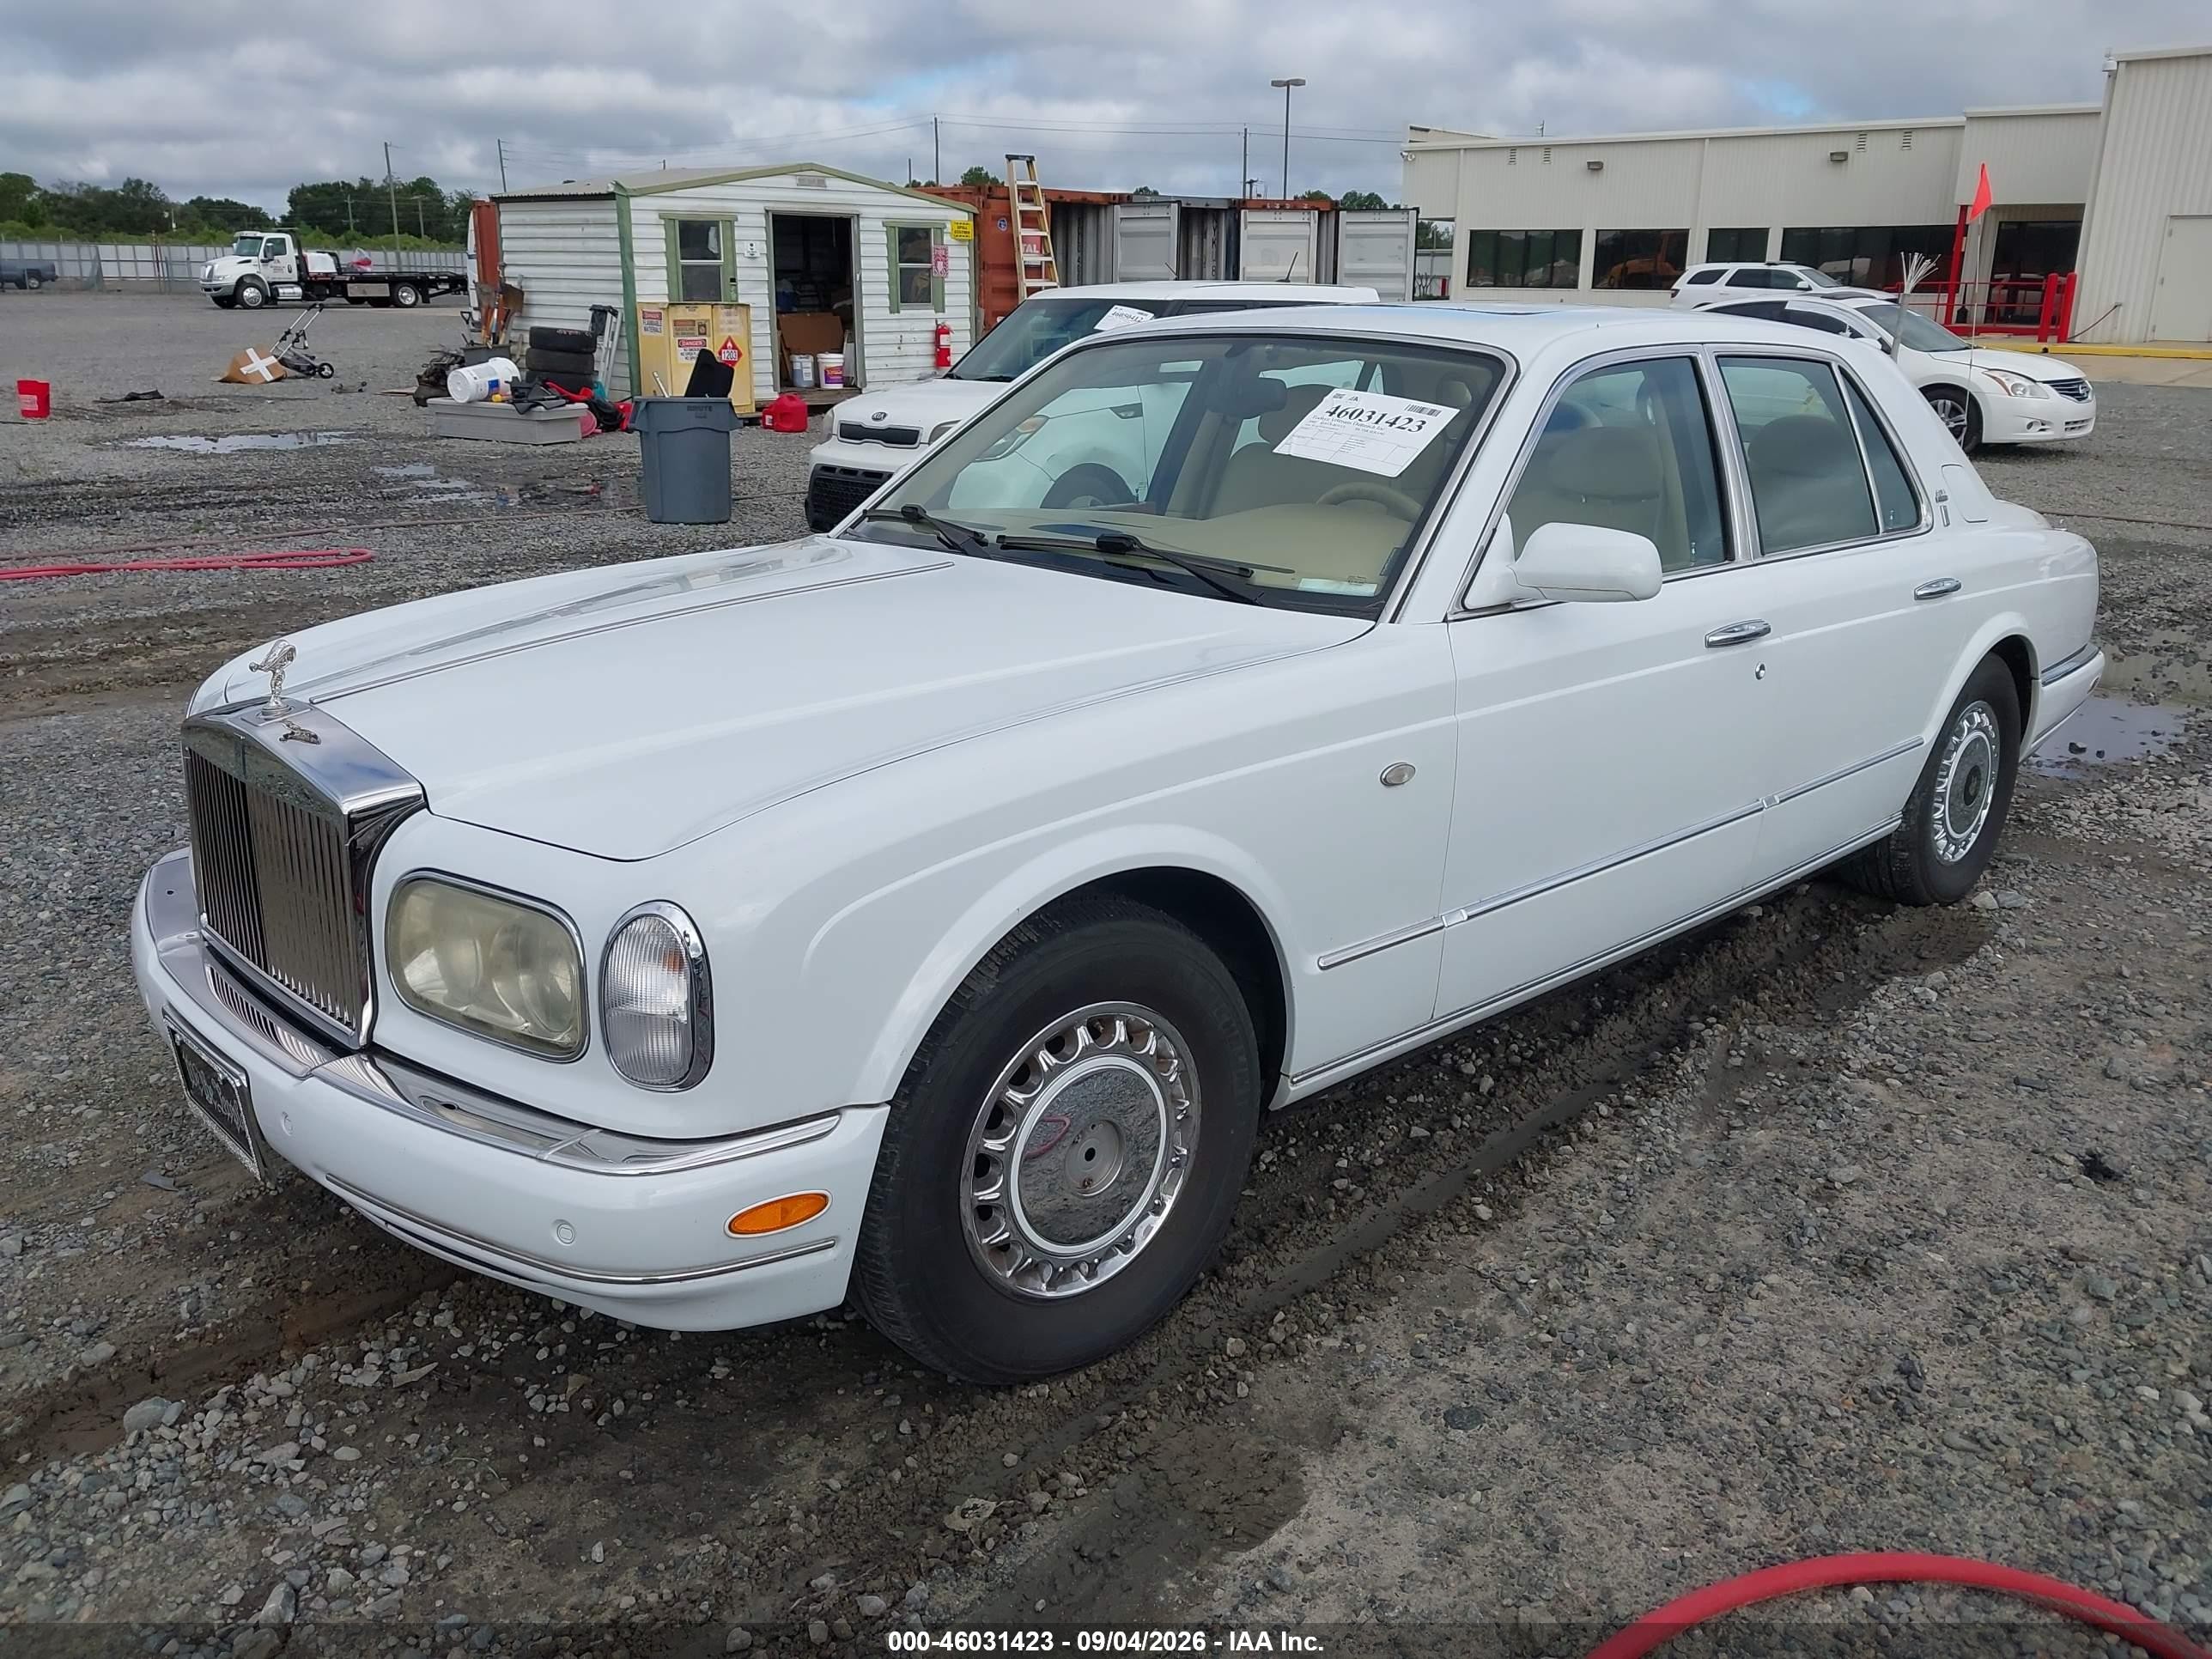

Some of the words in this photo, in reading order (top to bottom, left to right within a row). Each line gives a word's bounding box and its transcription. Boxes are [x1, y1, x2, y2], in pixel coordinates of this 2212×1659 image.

[723, 350, 737, 359] 1203
[872, 412, 887, 421] KIA
[1325, 404, 1427, 433] 46031423
